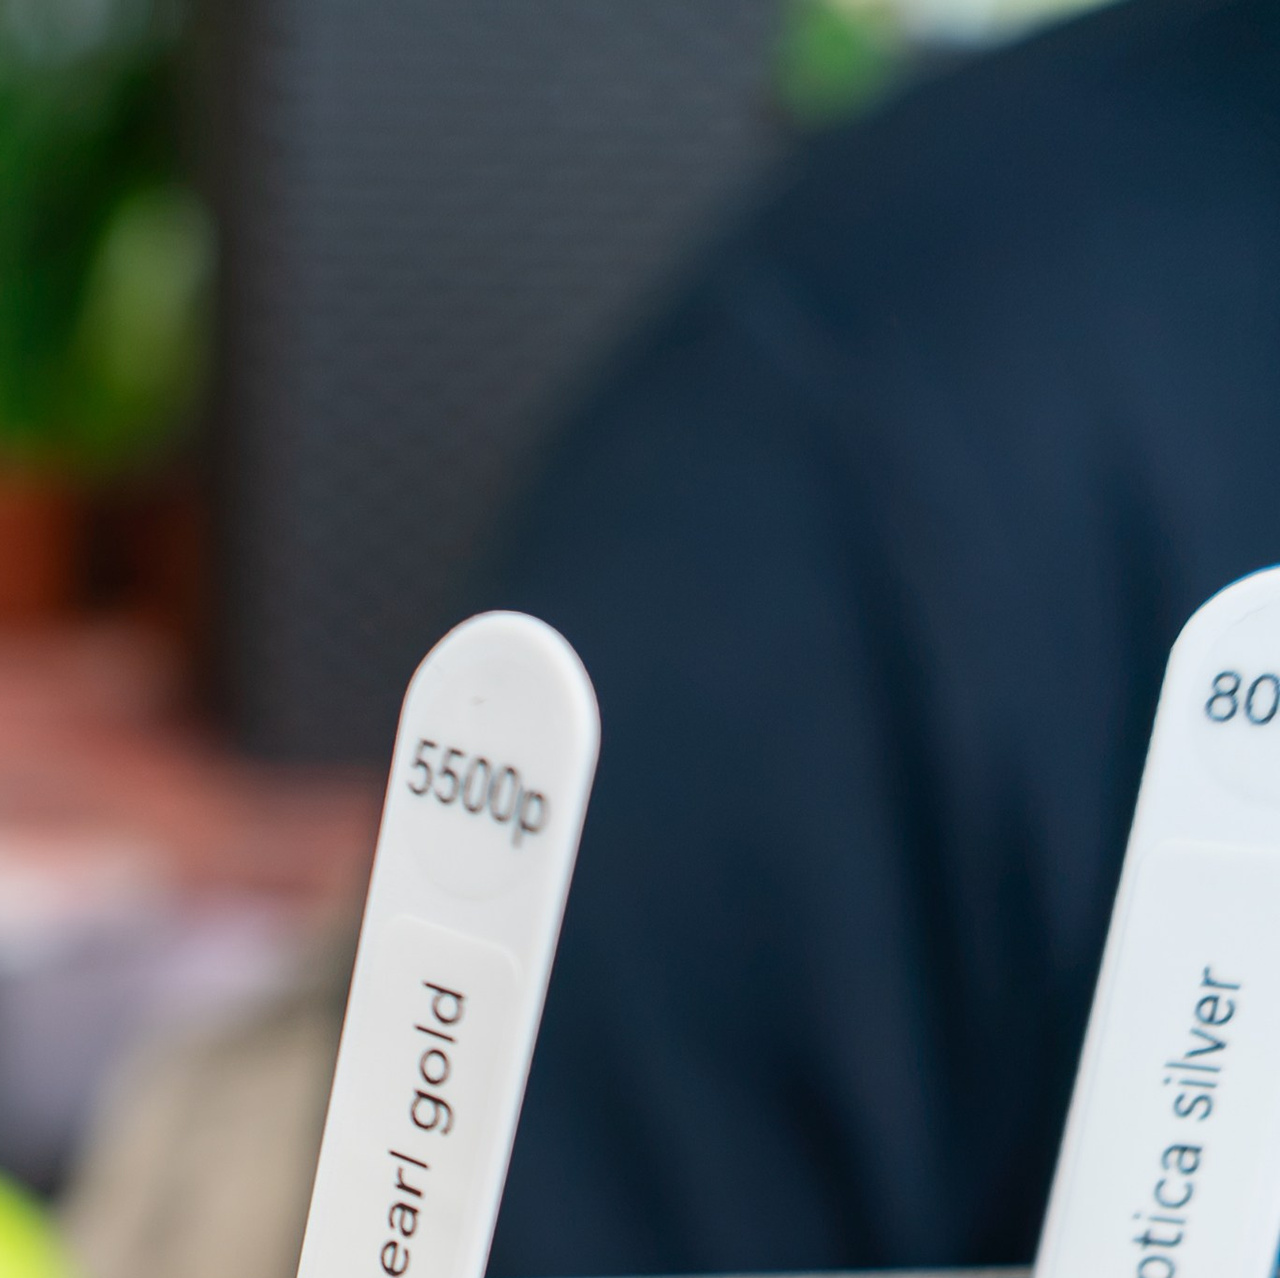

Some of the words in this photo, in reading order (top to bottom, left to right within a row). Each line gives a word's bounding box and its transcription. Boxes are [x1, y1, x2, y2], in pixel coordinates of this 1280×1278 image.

[1205, 670, 1280, 726] 80
[408, 738, 548, 850] 5500p
[409, 981, 466, 1136] gold
[1163, 965, 1241, 1122] silver
